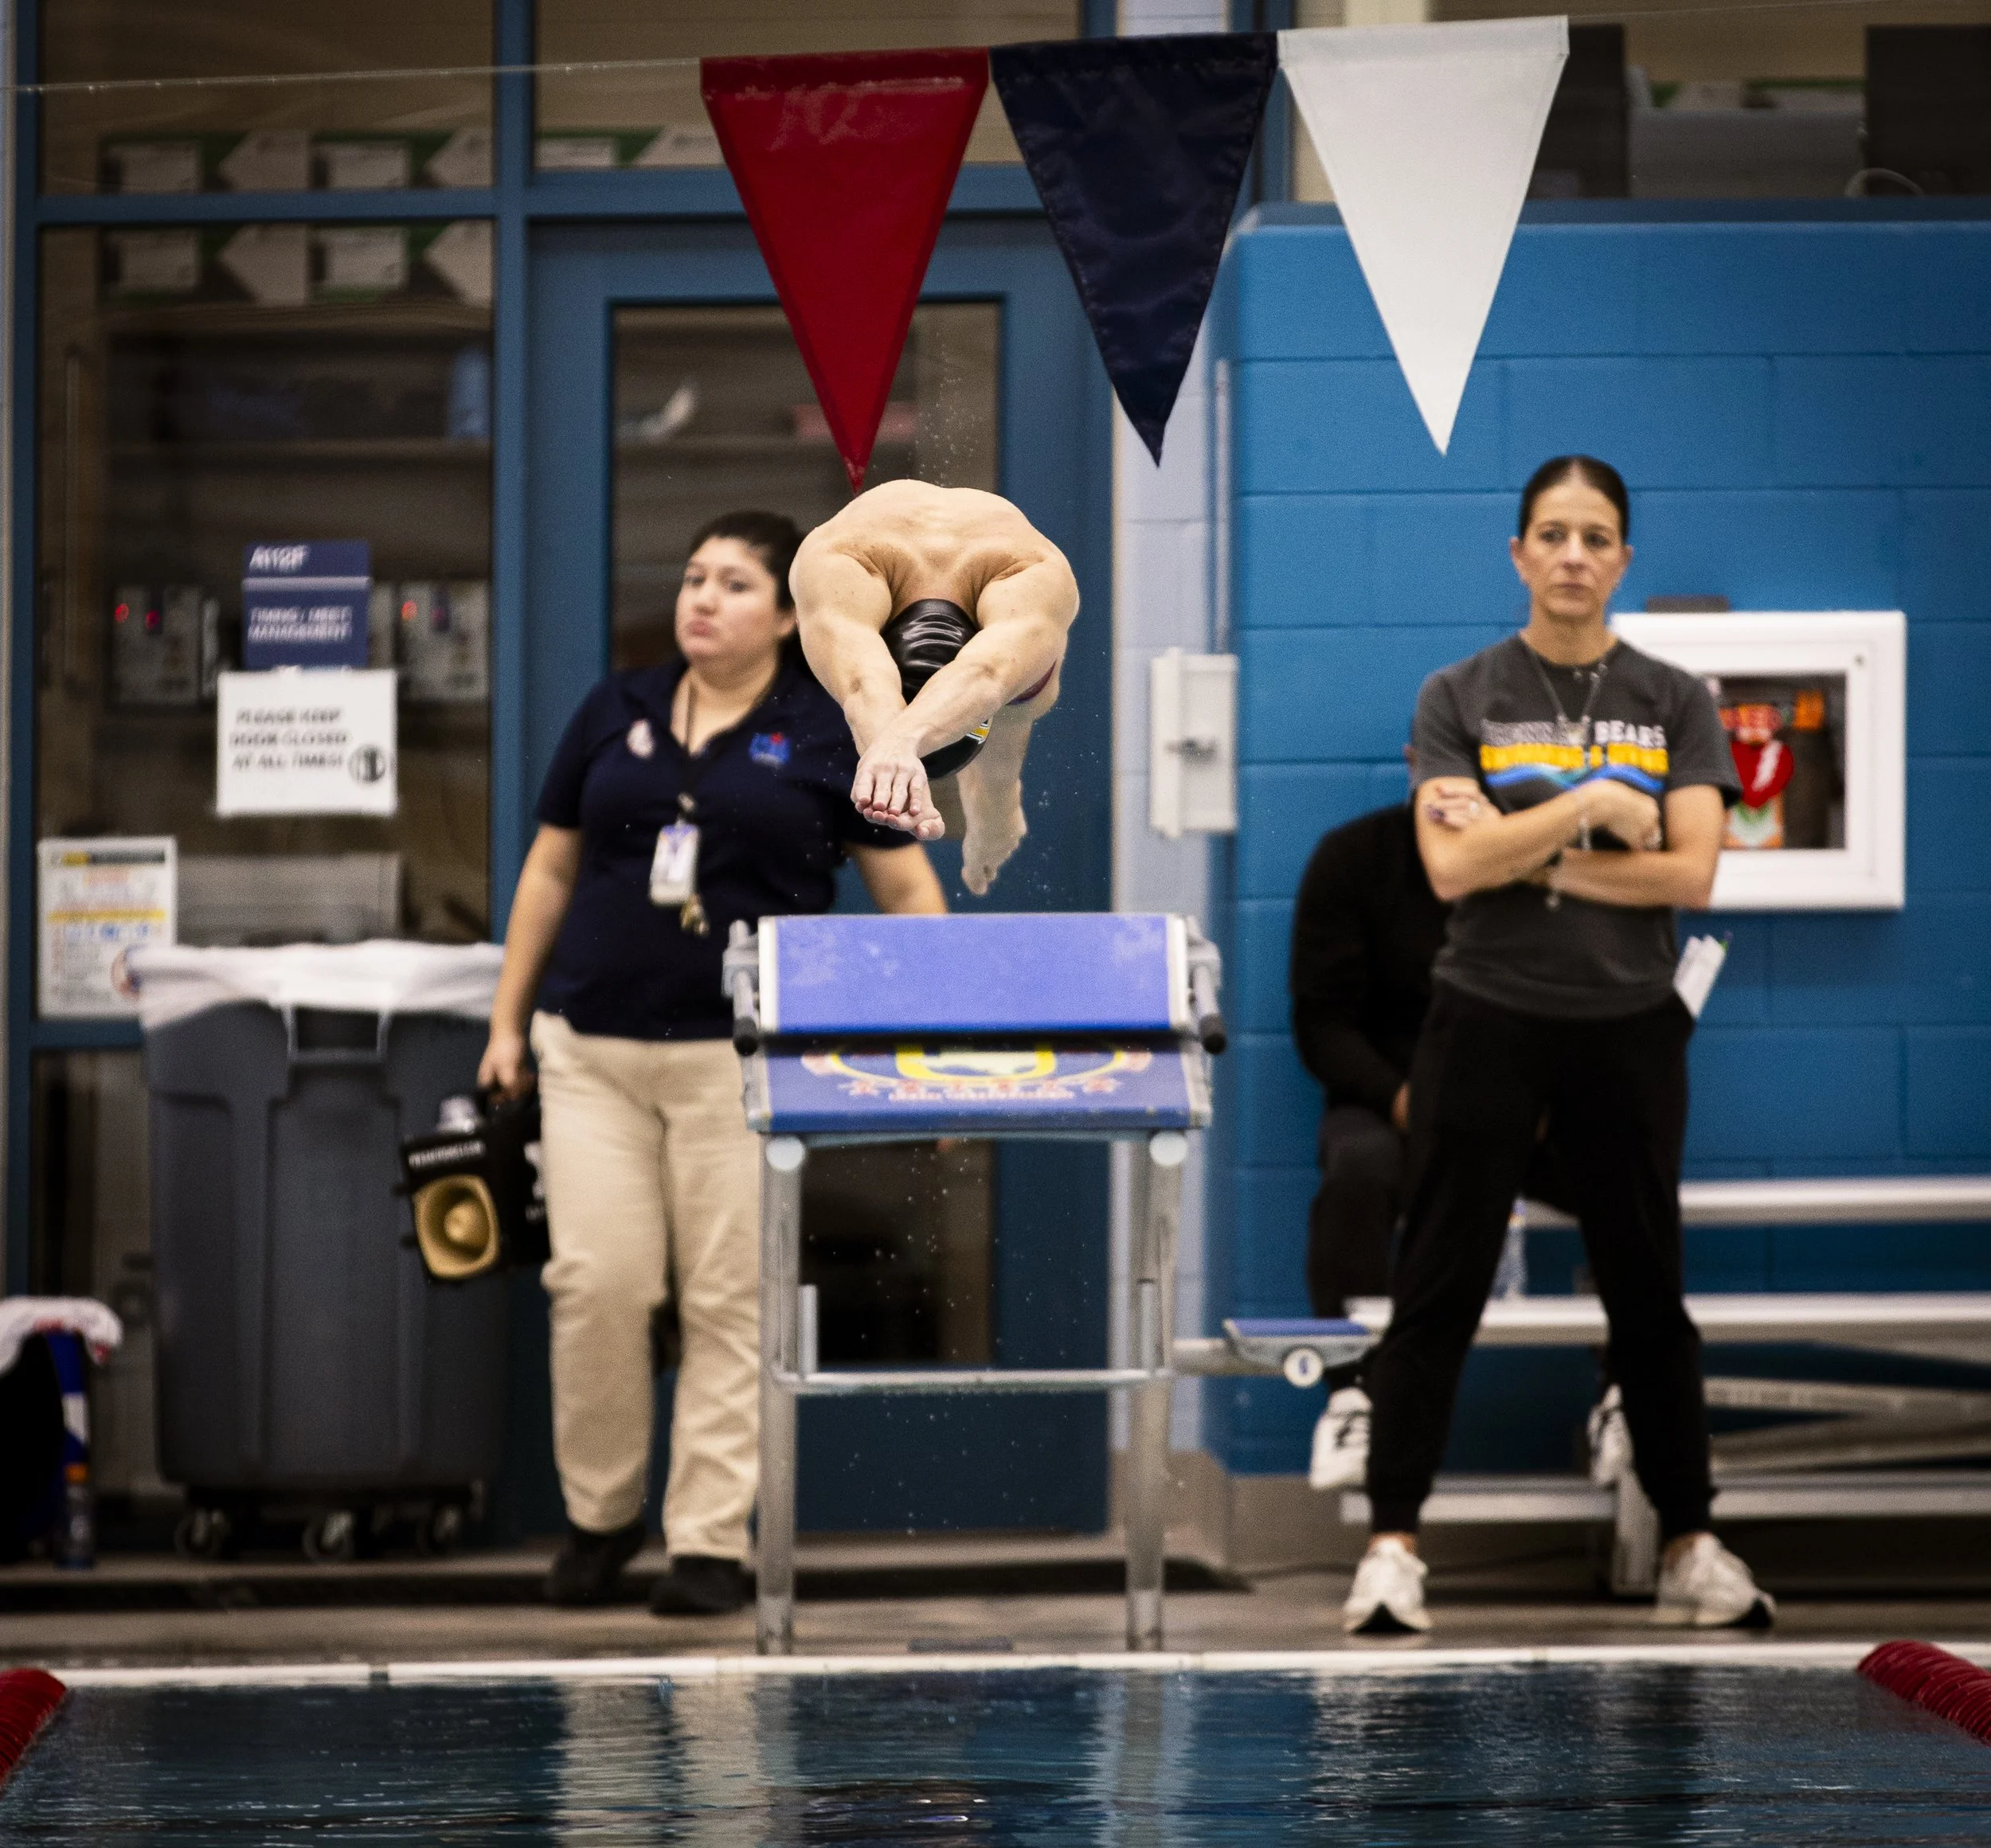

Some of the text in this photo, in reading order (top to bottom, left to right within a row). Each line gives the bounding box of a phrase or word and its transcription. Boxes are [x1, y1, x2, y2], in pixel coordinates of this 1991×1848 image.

[237, 706, 341, 725] PLEASE KEEP
[229, 730, 349, 747] DOOR CLOSED
[1594, 720, 1667, 748] BEARS
[233, 753, 252, 771] AT
[257, 753, 287, 771] ALL
